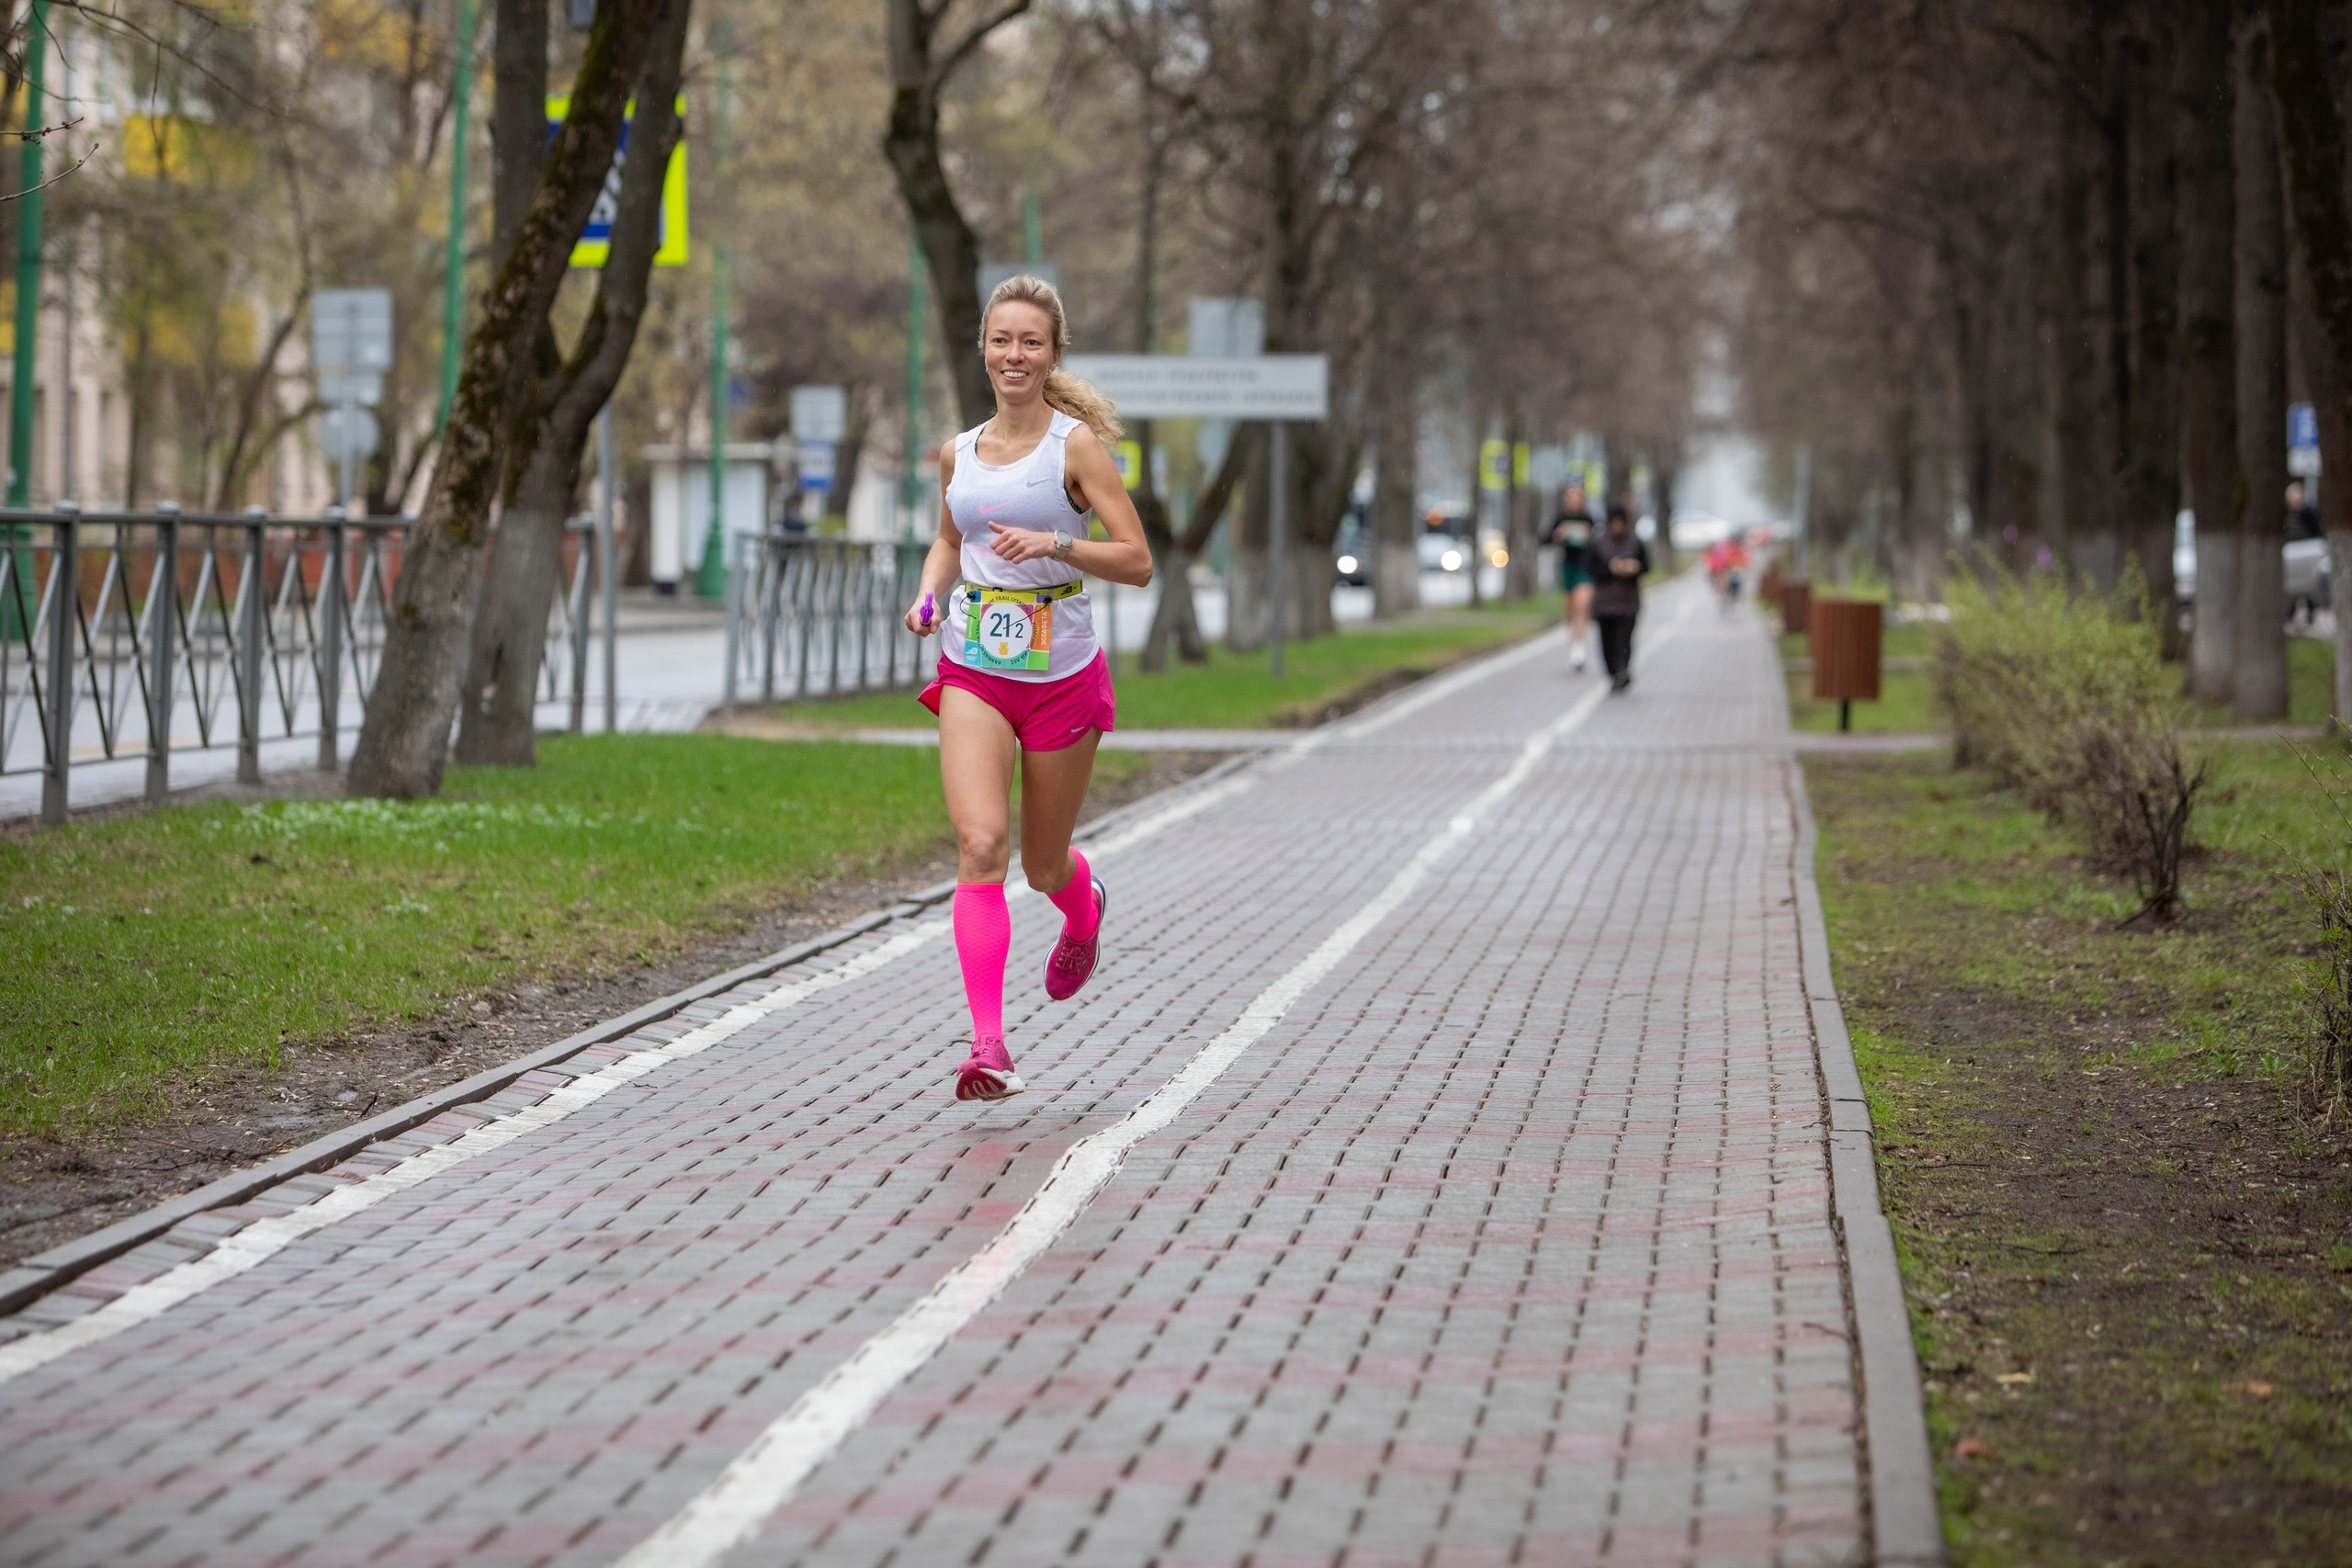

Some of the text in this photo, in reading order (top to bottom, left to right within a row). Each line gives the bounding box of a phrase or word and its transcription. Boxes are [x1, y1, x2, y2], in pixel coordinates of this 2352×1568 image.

[1011, 596, 1031, 613] LYSKOVO
[1040, 611, 1048, 646] ЭСТАФЕТА
[1010, 657, 1021, 665] ЛЕС
